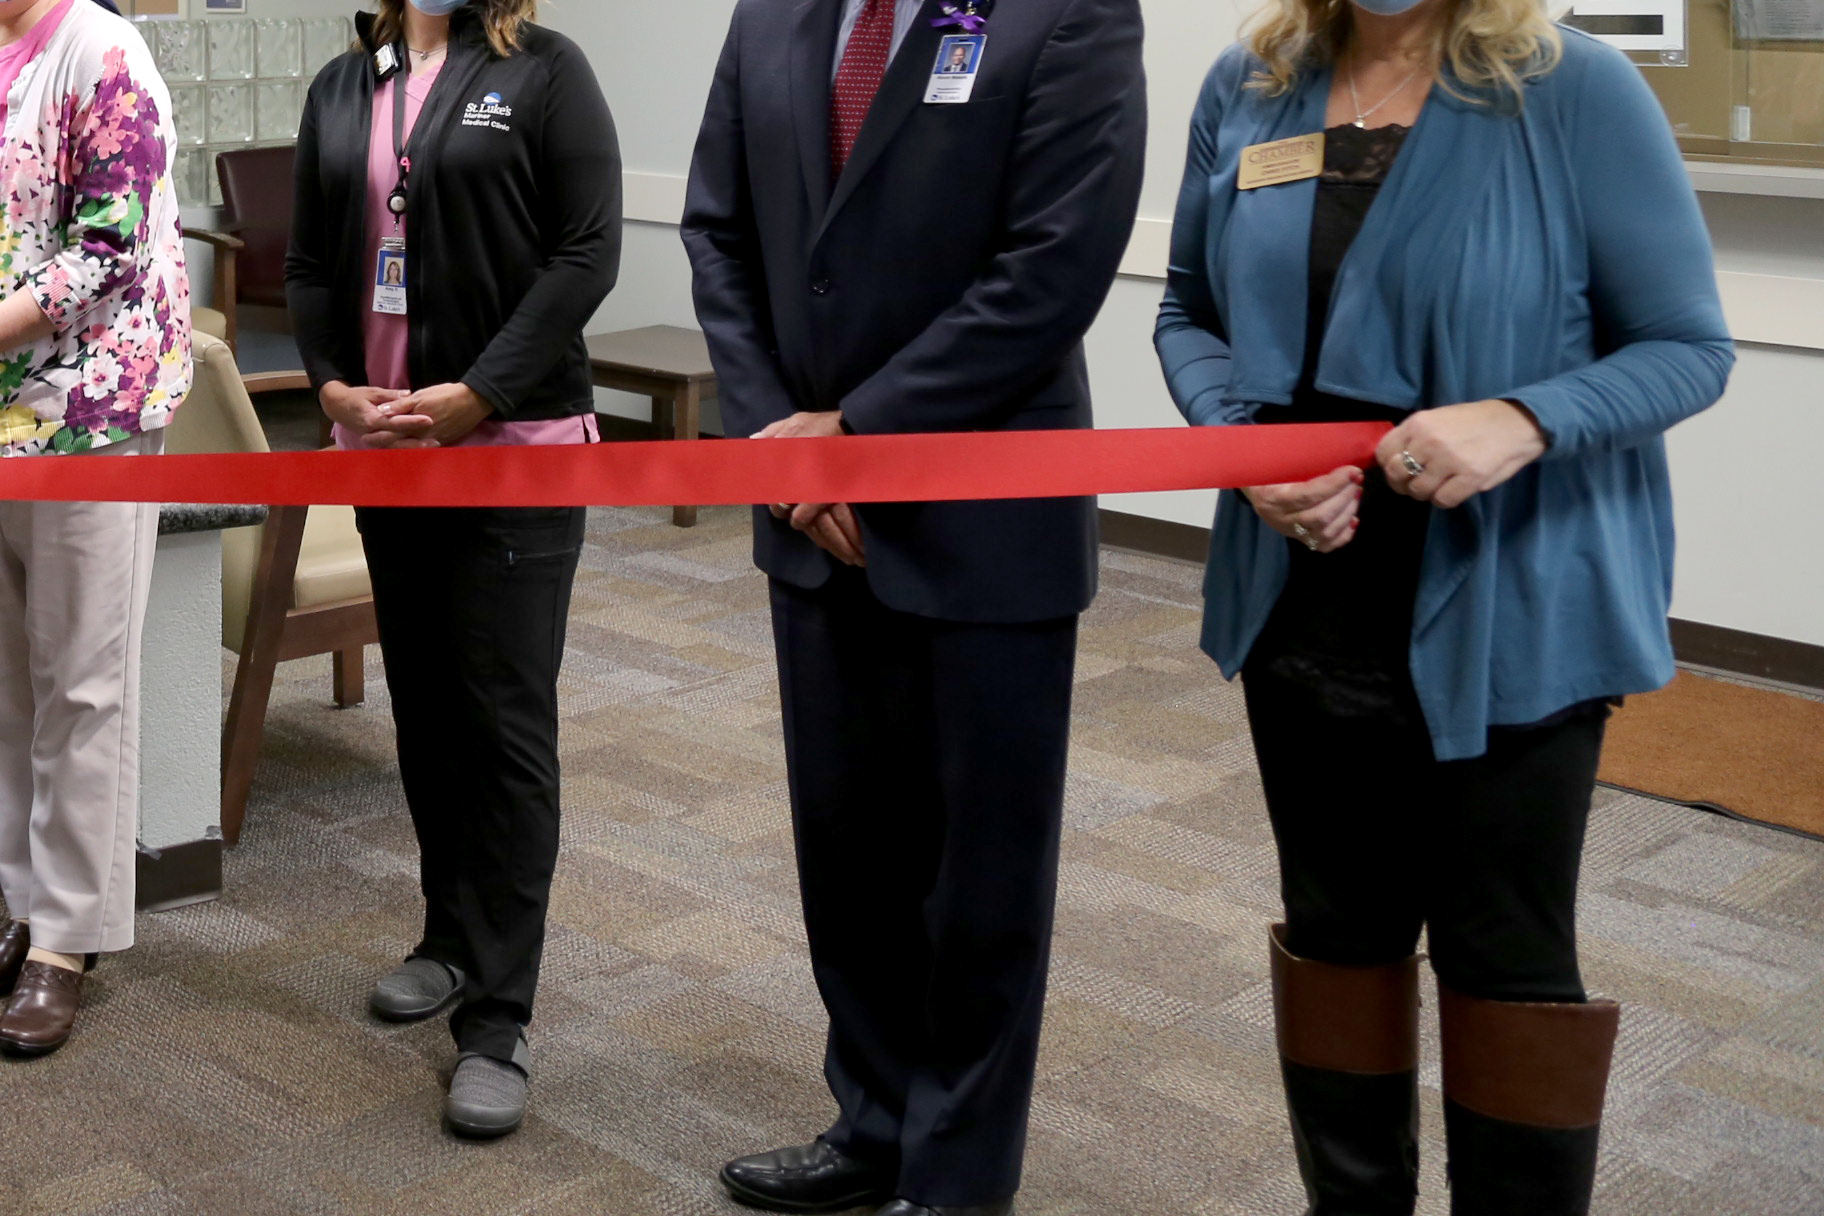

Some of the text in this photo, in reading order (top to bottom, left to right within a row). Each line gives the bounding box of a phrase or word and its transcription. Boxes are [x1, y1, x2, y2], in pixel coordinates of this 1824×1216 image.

[479, 103, 512, 116] Luke's
[490, 121, 510, 131] Clinic
[1248, 141, 1314, 163] CHAMBER
